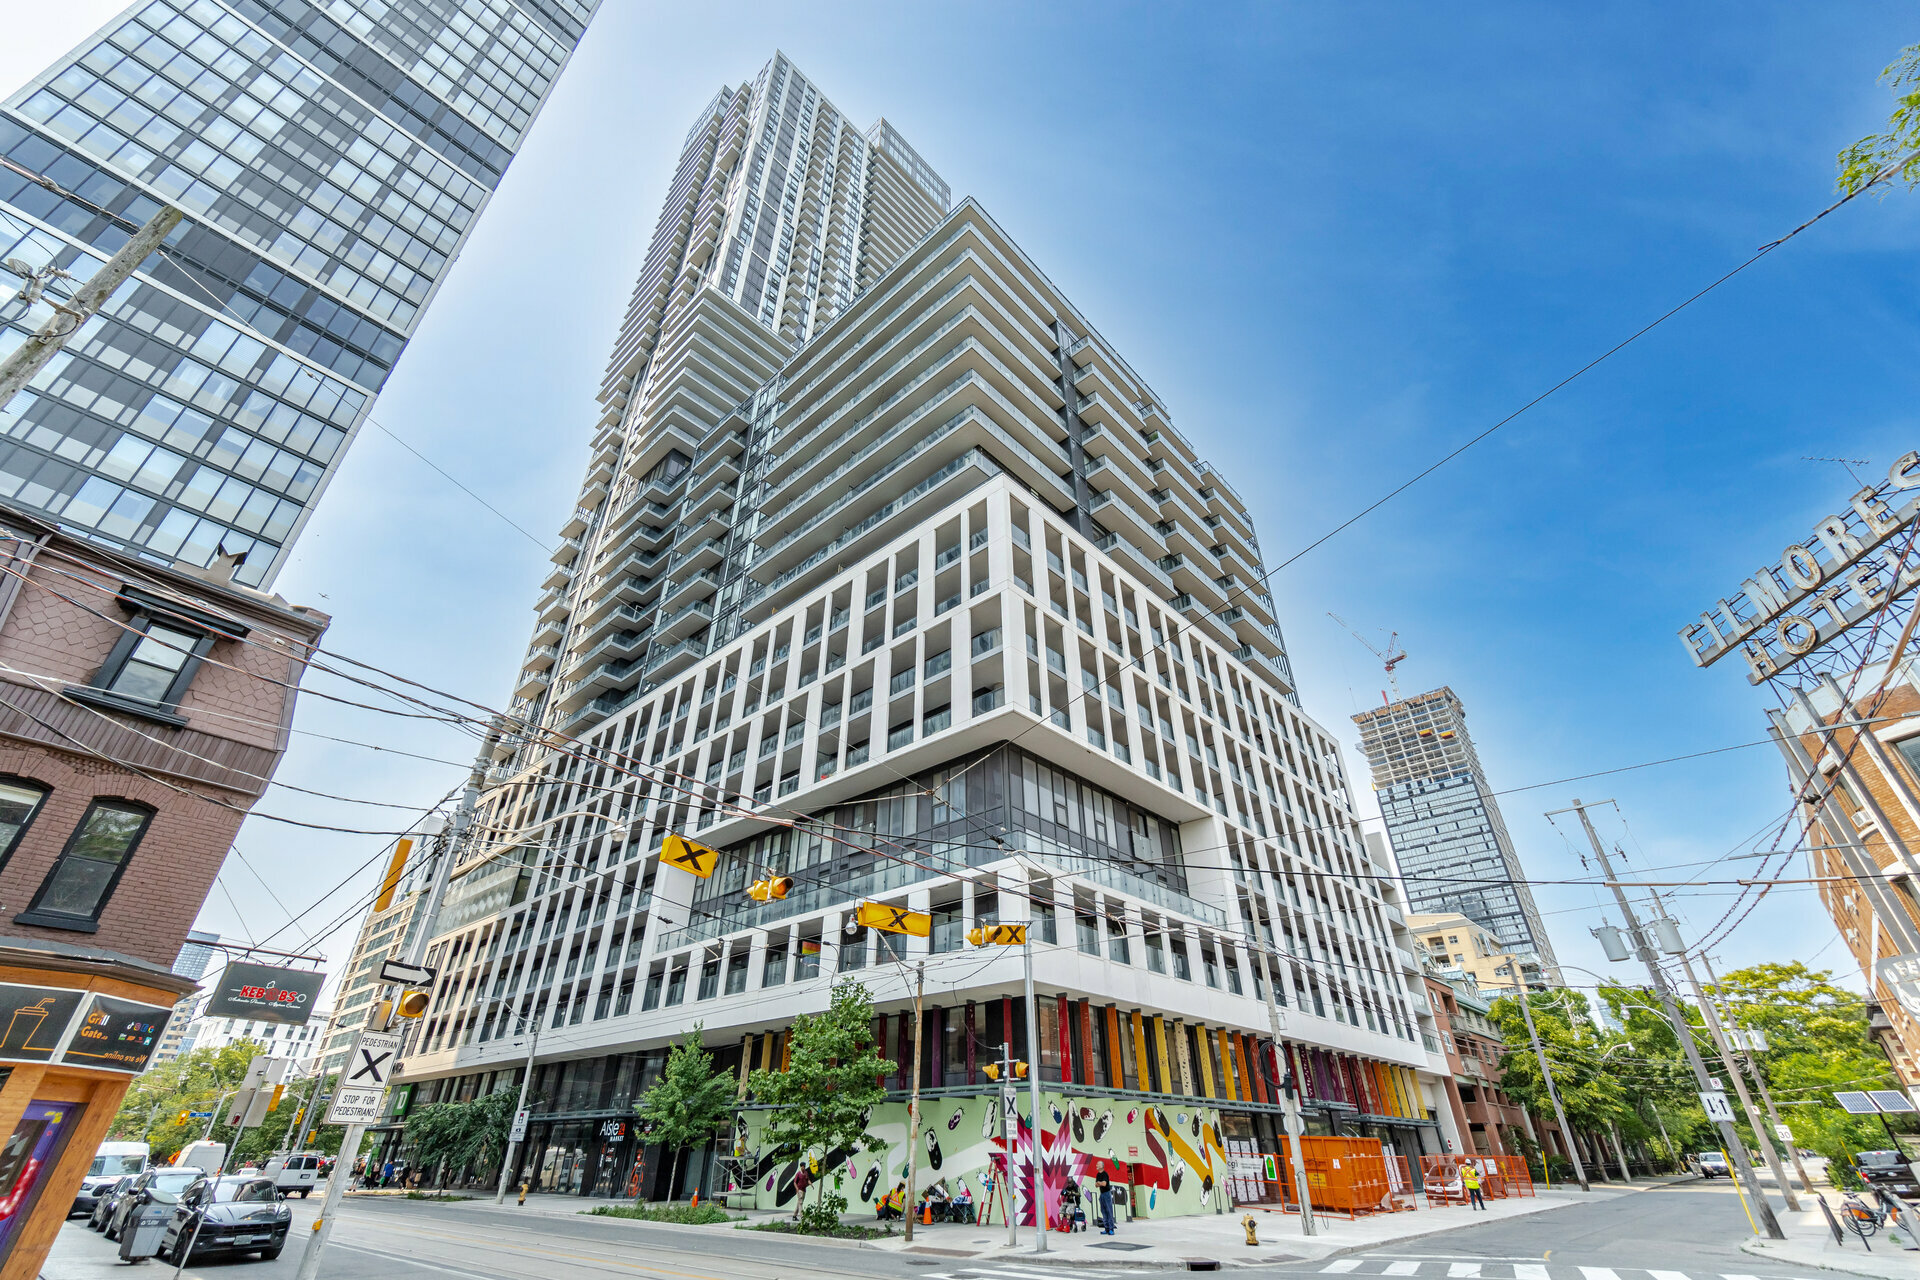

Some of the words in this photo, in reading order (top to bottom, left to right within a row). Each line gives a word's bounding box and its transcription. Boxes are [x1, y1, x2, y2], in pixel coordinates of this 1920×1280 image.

[1740, 548, 1920, 682] HOTEL
[88, 1012, 111, 1026] Grill
[361, 1037, 398, 1049] PEDESTRIAN
[342, 1094, 360, 1104] STOP
[362, 1096, 376, 1105] FOR
[334, 1106, 375, 1117] PEDESTRIANS
